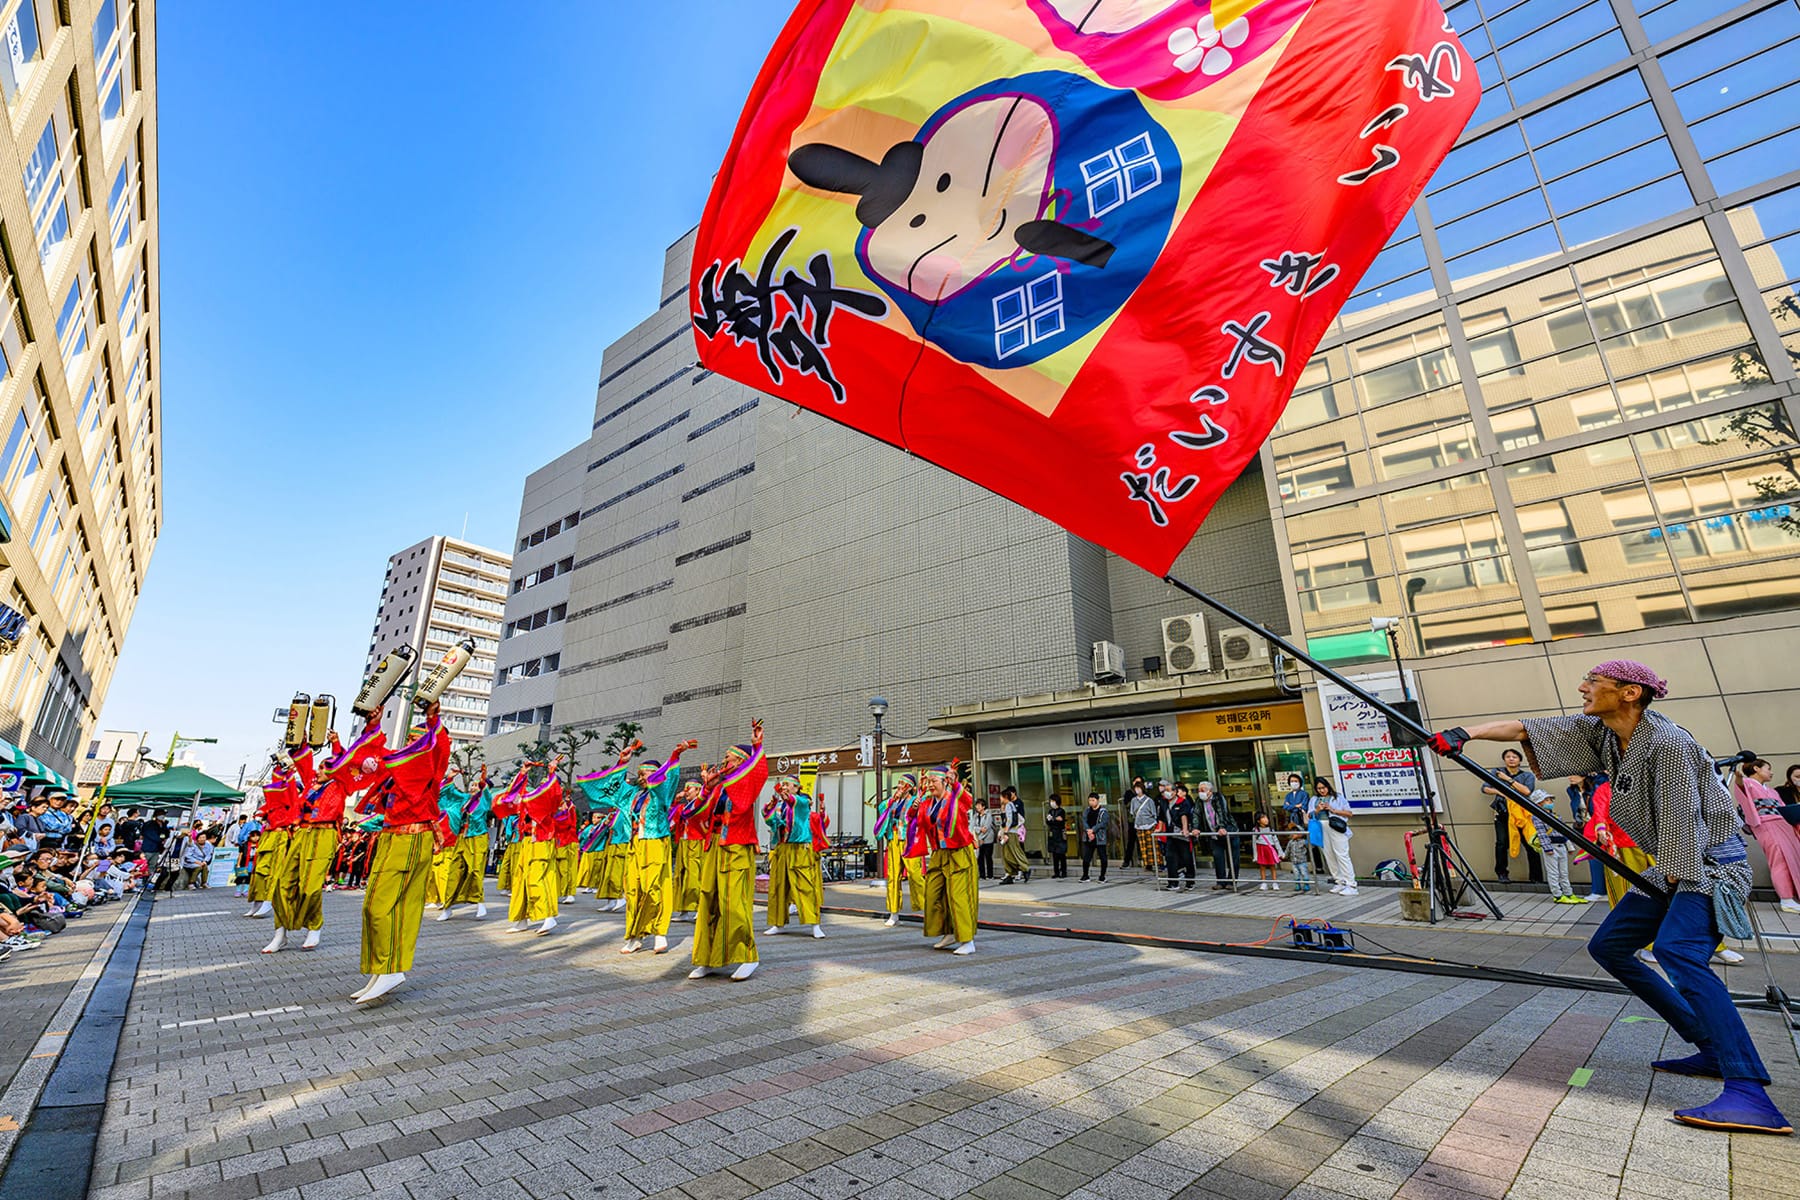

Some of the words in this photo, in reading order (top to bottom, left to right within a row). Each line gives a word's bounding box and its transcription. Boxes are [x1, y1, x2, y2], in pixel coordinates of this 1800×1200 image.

[1215, 710, 1271, 724] 岩槻区役所
[1074, 729, 1112, 746] WATSU
[1115, 725, 1165, 741] 専門店街
